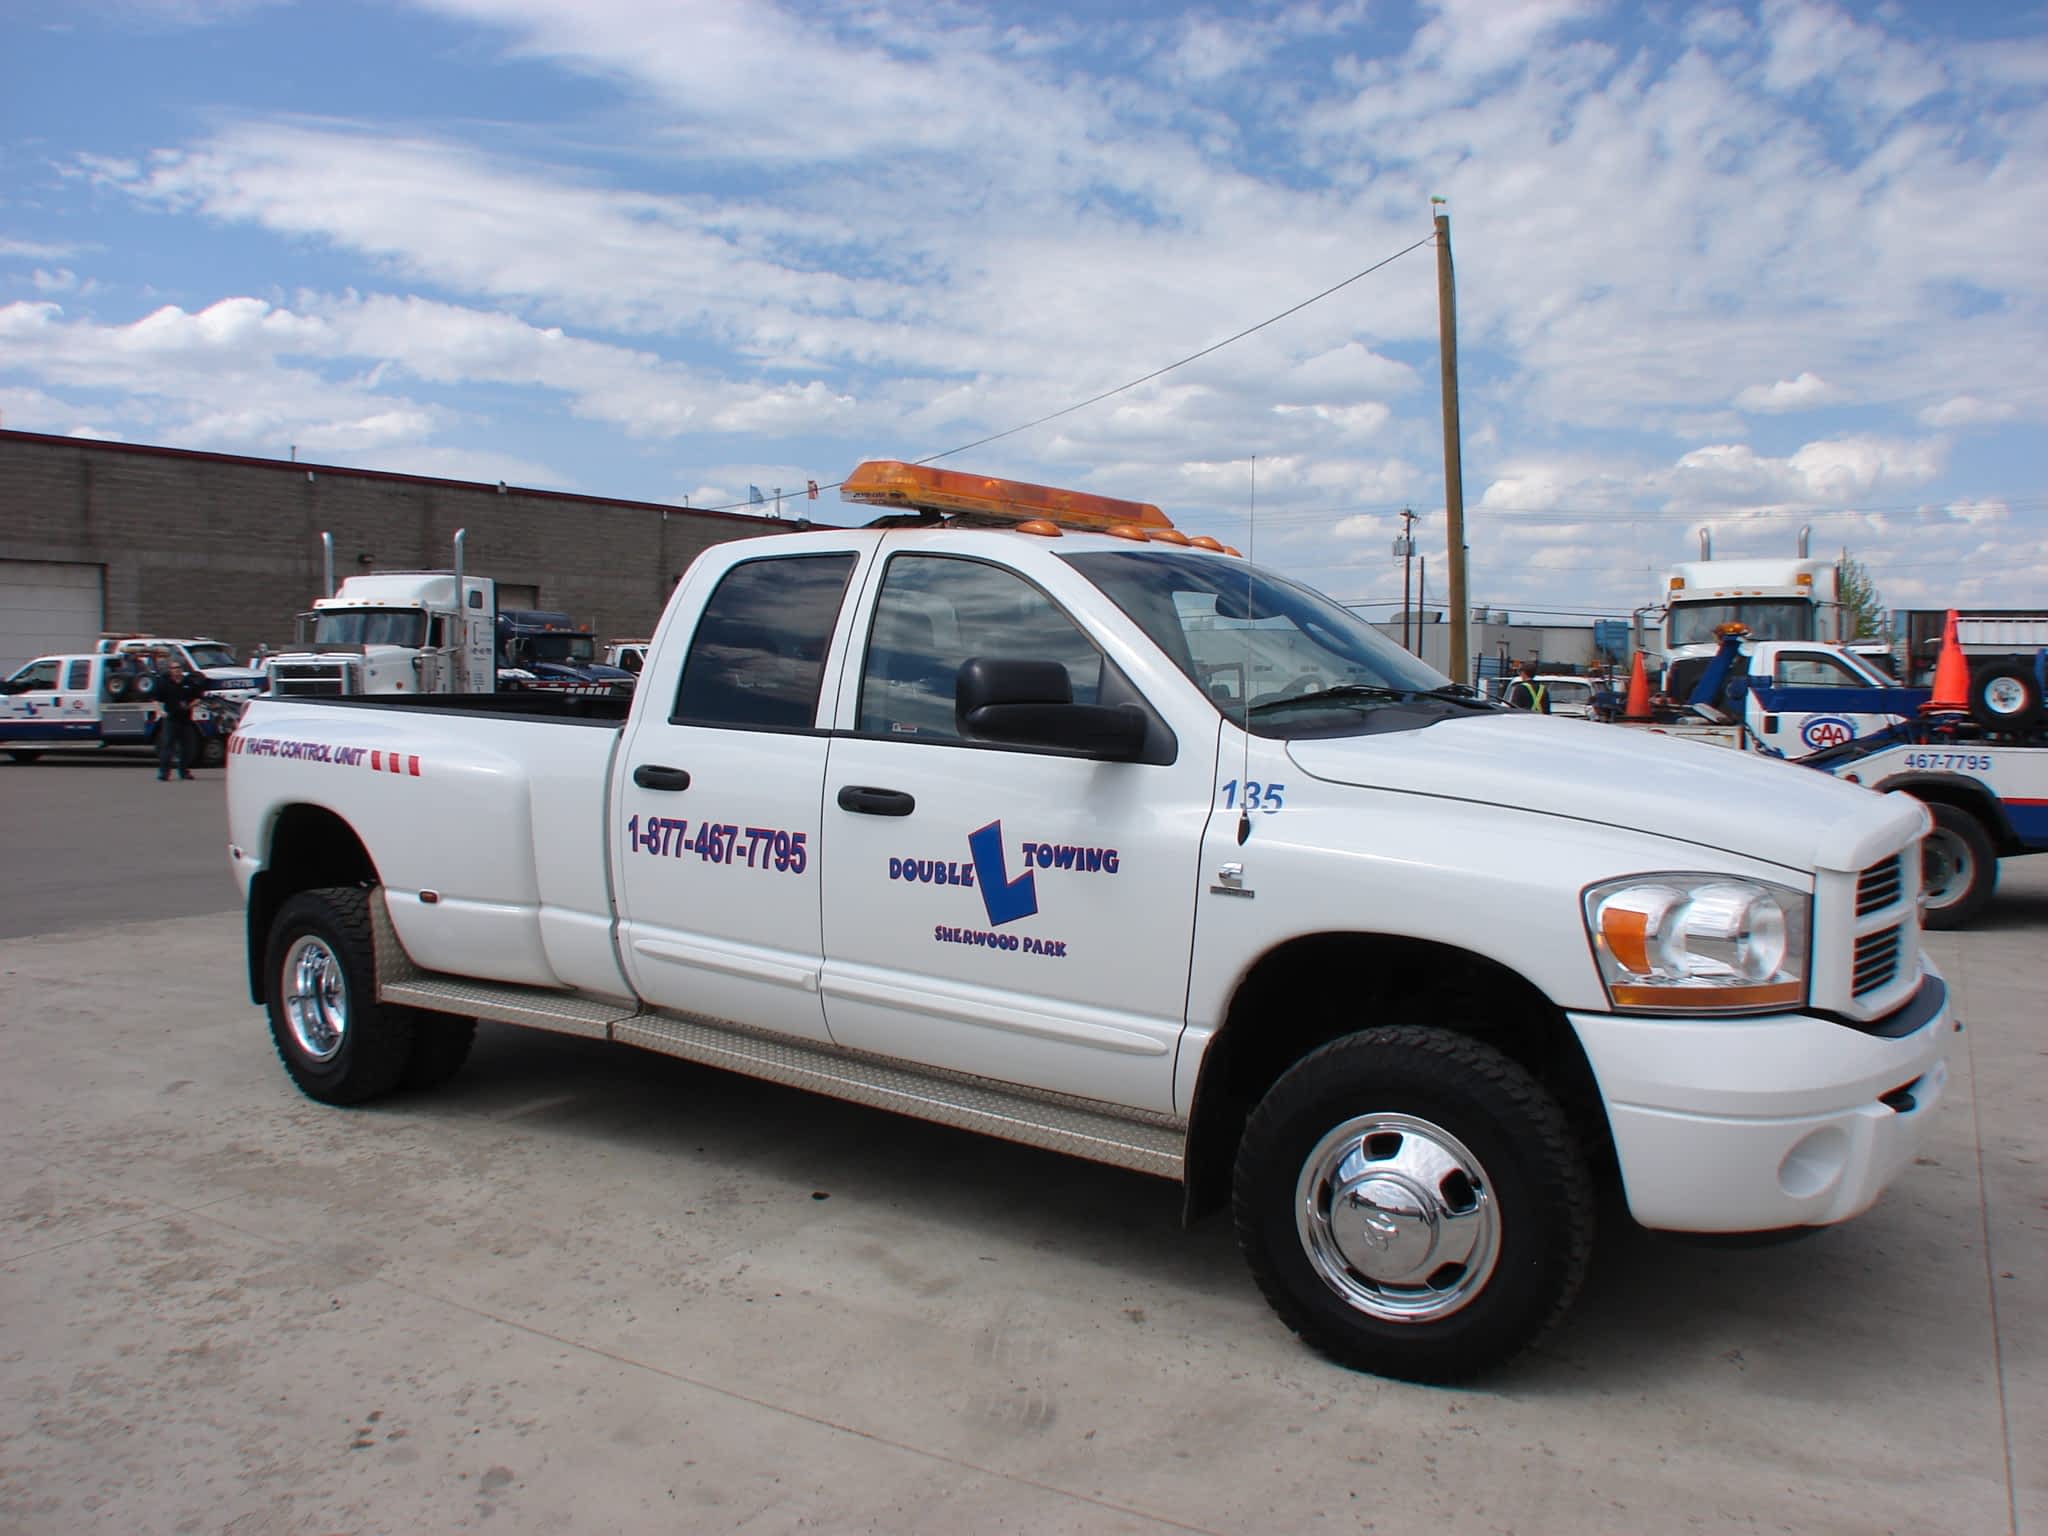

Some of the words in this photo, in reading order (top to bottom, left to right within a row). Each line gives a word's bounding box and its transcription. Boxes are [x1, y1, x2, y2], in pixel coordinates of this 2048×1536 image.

[246, 737, 280, 757] TRAFFIC
[280, 741, 332, 763] CONTROL
[334, 746, 368, 766] UNIT
[1810, 724, 1845, 747] CAA
[1904, 753, 1991, 770] 467-7795
[1222, 779, 1285, 814] 135
[628, 814, 807, 874] 1-877-467-7795
[889, 857, 975, 887] DOUBLE
[967, 819, 1038, 927] L
[1022, 843, 1120, 874] TOWING
[934, 925, 1019, 951] SHERWOOD
[1023, 936, 1067, 957] PARK
